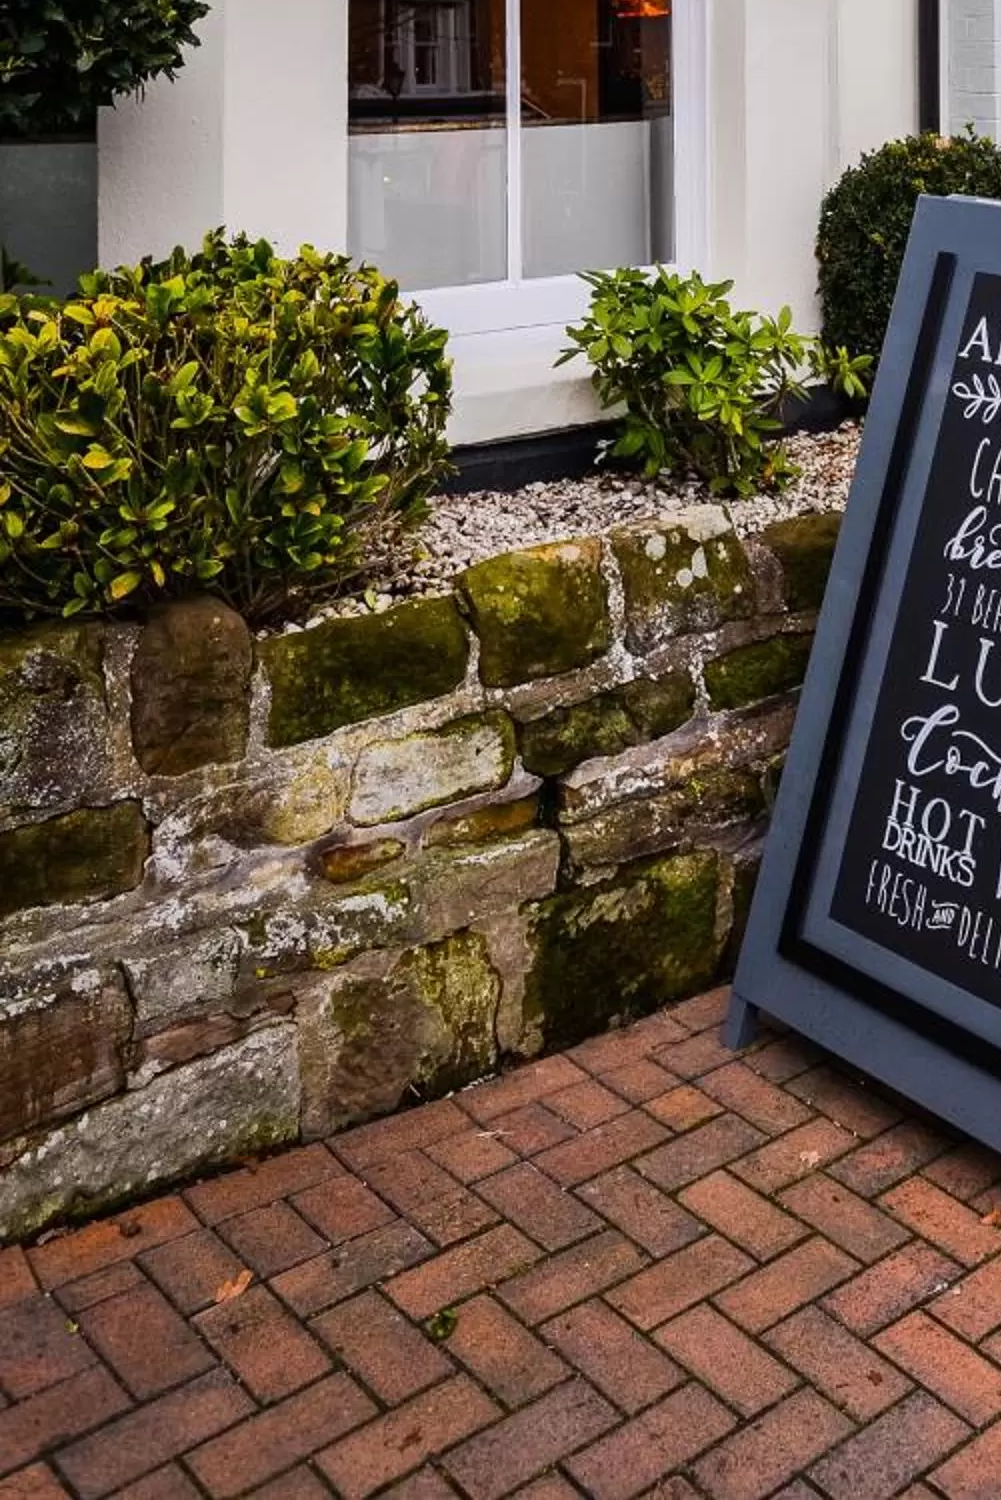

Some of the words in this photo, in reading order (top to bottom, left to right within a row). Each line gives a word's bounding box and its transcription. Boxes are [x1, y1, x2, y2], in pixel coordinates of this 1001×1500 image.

[941, 573, 966, 616] 31
[889, 779, 985, 857] HOT
[882, 820, 976, 886] DRINKS
[866, 859, 926, 931] FRESH
